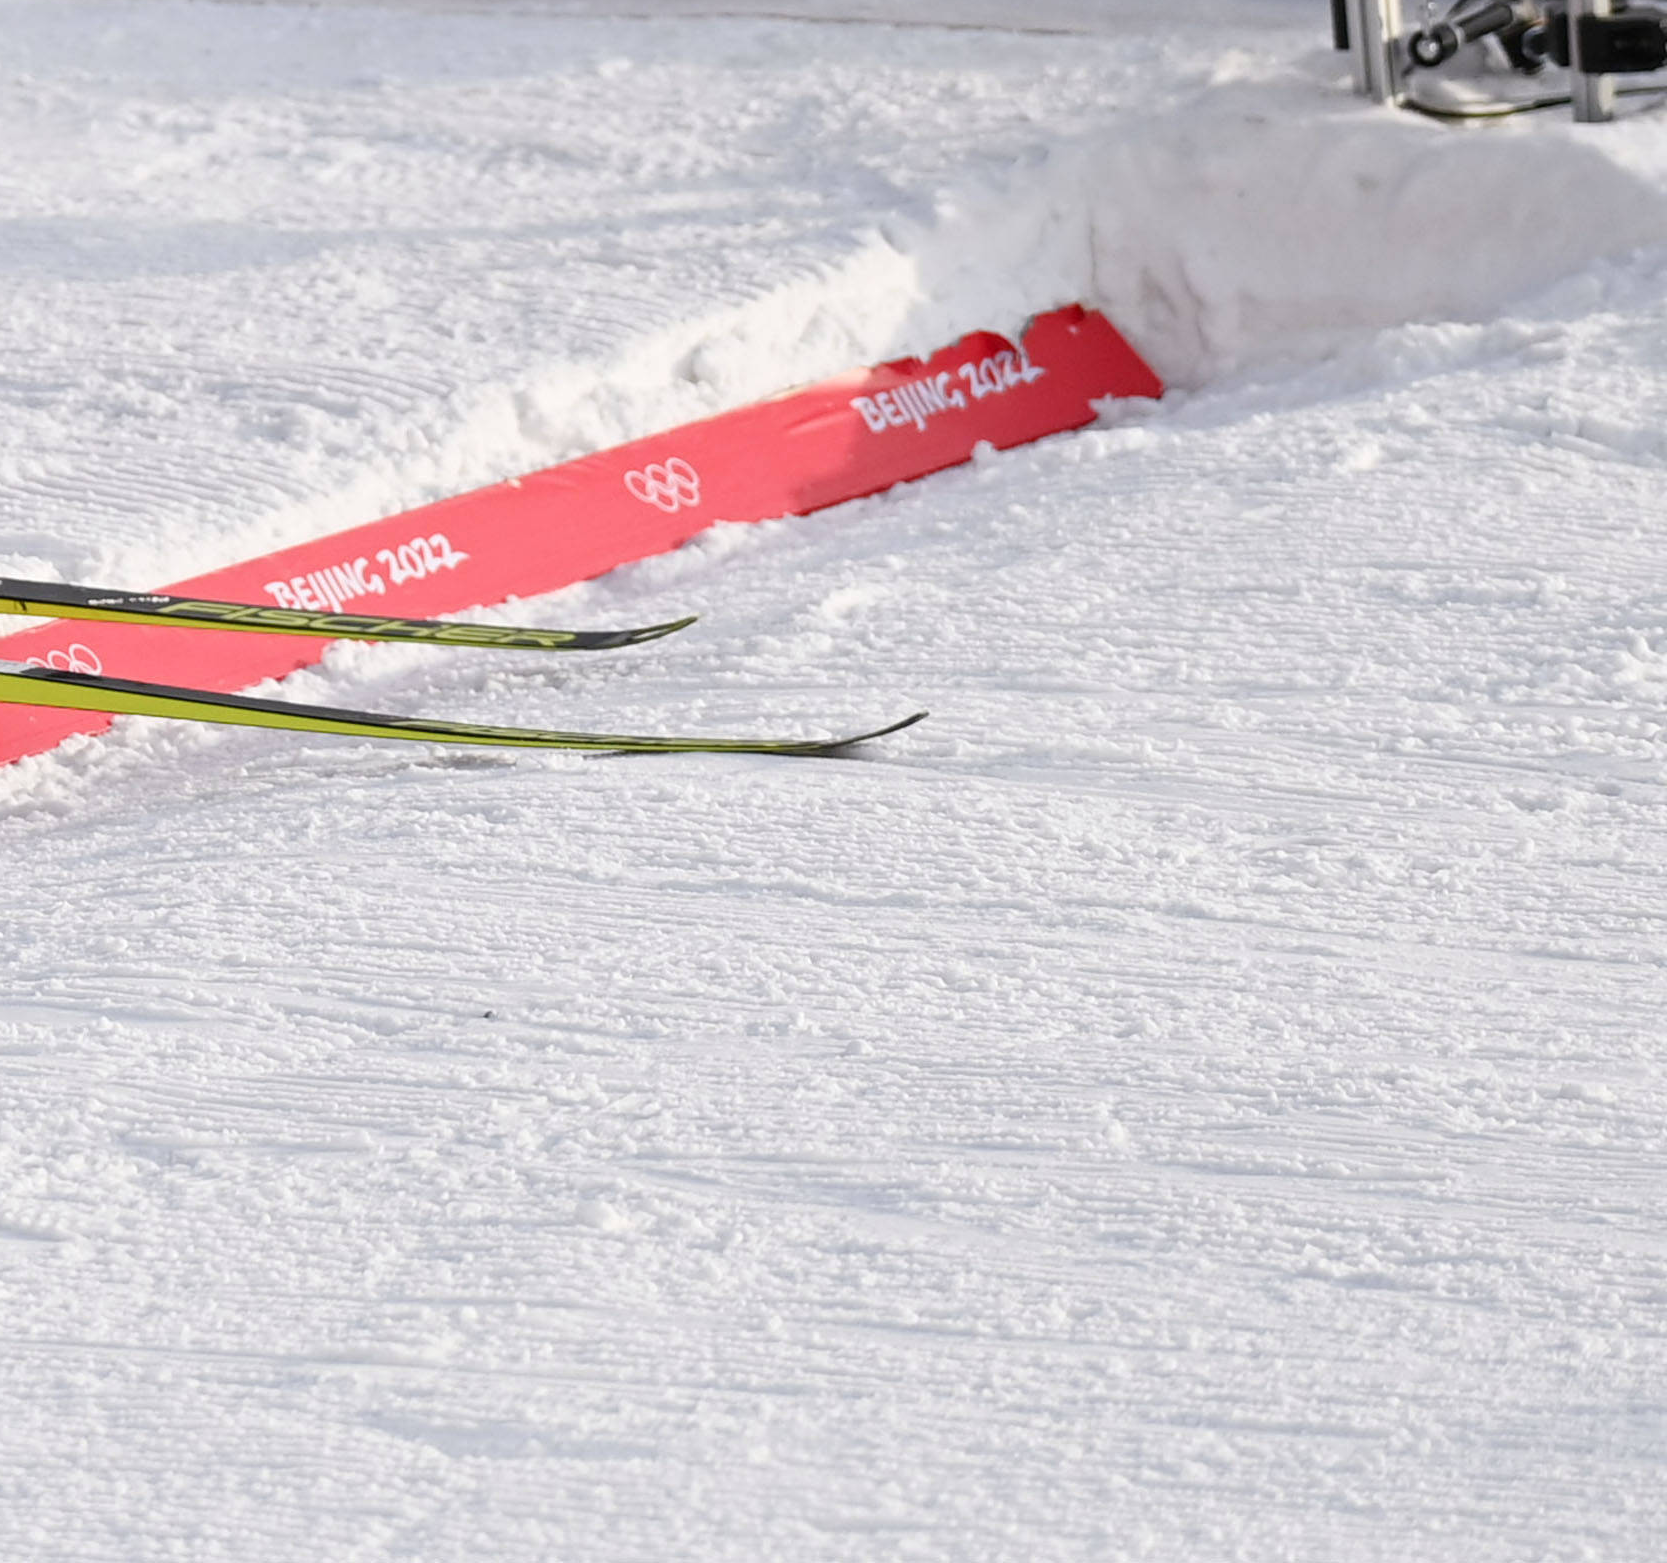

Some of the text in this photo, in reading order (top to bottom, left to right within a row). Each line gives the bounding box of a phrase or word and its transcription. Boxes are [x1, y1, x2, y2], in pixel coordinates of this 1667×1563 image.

[850, 371, 967, 433] BEIJING
[264, 532, 471, 614] BEIJING 2022
